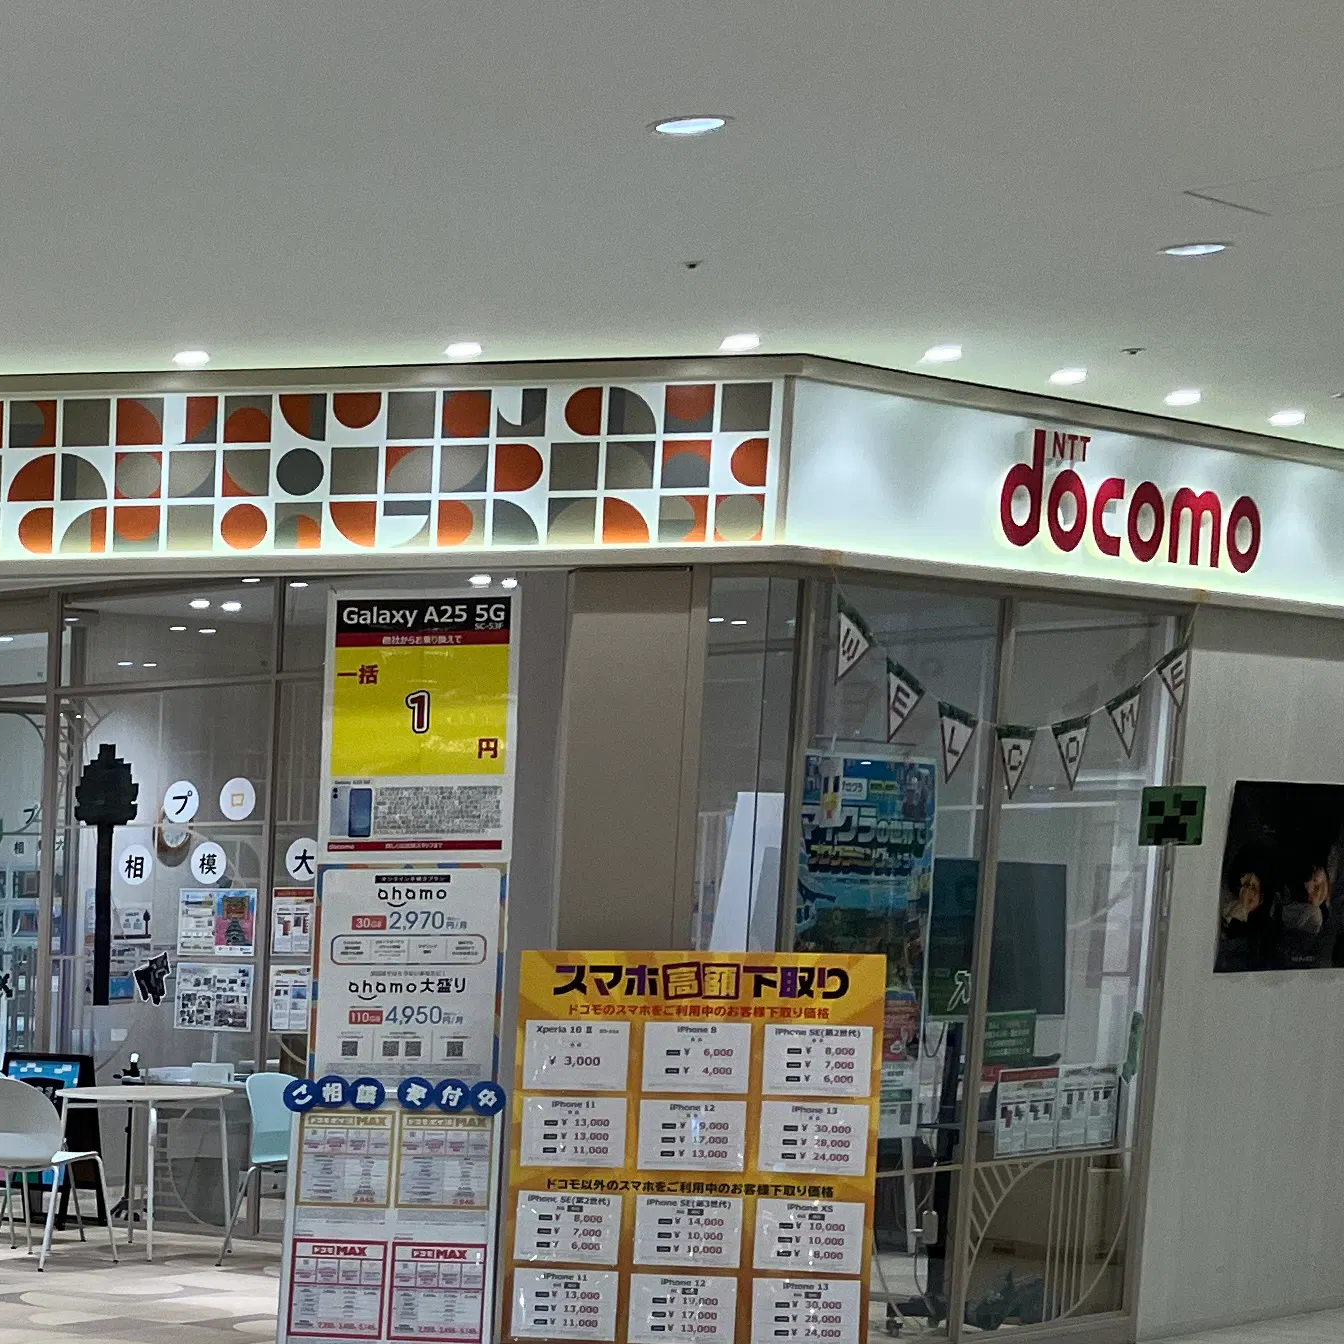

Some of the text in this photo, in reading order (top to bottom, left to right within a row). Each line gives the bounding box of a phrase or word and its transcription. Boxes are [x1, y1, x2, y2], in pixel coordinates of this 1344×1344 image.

[1053, 431, 1090, 461] NTT
[1001, 429, 1261, 573] docomo
[343, 604, 505, 630] Galaxy A25 5G
[337, 665, 379, 684] 一括
[406, 690, 430, 734] 1
[478, 738, 499, 759] 円
[378, 886, 447, 901] ahamo
[355, 917, 382, 929] 30GB
[553, 961, 850, 1000] スマホ高額下取り
[348, 978, 466, 994] ahamo大盛り
[568, 1003, 830, 1019] ドコモのスマホをご利用中のお客様下取り価格
[351, 1012, 381, 1023] 110GB
[536, 1025, 567, 1035] Xperia
[775, 1028, 806, 1036] iPhone
[703, 1049, 733, 1058] 6,000
[825, 1047, 855, 1056] 8,000
[564, 1056, 600, 1067] 3,000
[825, 1061, 854, 1070] 7,000
[702, 1067, 732, 1076] 4,000
[824, 1075, 853, 1084] 6,000
[792, 1106, 823, 1114] iPhone
[357, 1117, 387, 1126] MAX
[455, 1118, 488, 1128] MAX
[574, 1119, 610, 1128] 13,000
[815, 1125, 851, 1134] 30,000
[573, 1133, 609, 1142] 13,000
[814, 1139, 850, 1148] 28,000
[573, 1146, 608, 1155] 11,000
[692, 1150, 727, 1159] 13,000
[813, 1153, 849, 1162] 24,000
[547, 1178, 833, 1198] ドコモ以外のスマホをご利用中のお客様下取り価格
[787, 1204, 818, 1212] iPhone
[574, 1215, 602, 1223] 8,000
[688, 1218, 724, 1227] 14,000
[809, 1223, 845, 1232] 10,000
[573, 1228, 601, 1238] 7,000
[688, 1232, 723, 1241] 10,000
[809, 1237, 844, 1246] 10,000
[572, 1242, 600, 1251] 6,000
[686, 1246, 722, 1254] 10,000
[336, 1246, 367, 1257] MAX
[436, 1250, 468, 1260] MAX
[813, 1251, 843, 1260] 8,000
[661, 1278, 705, 1287] iPhone 12
[783, 1282, 814, 1290] iPhone
[565, 1291, 600, 1300] 13,000
[564, 1305, 598, 1314] 13,000
[805, 1301, 841, 1310] 30,000
[682, 1311, 717, 1320] 17,000
[805, 1315, 841, 1324] 28,000
[681, 1325, 716, 1333] 13,000
[805, 1329, 841, 1338] 24,000
